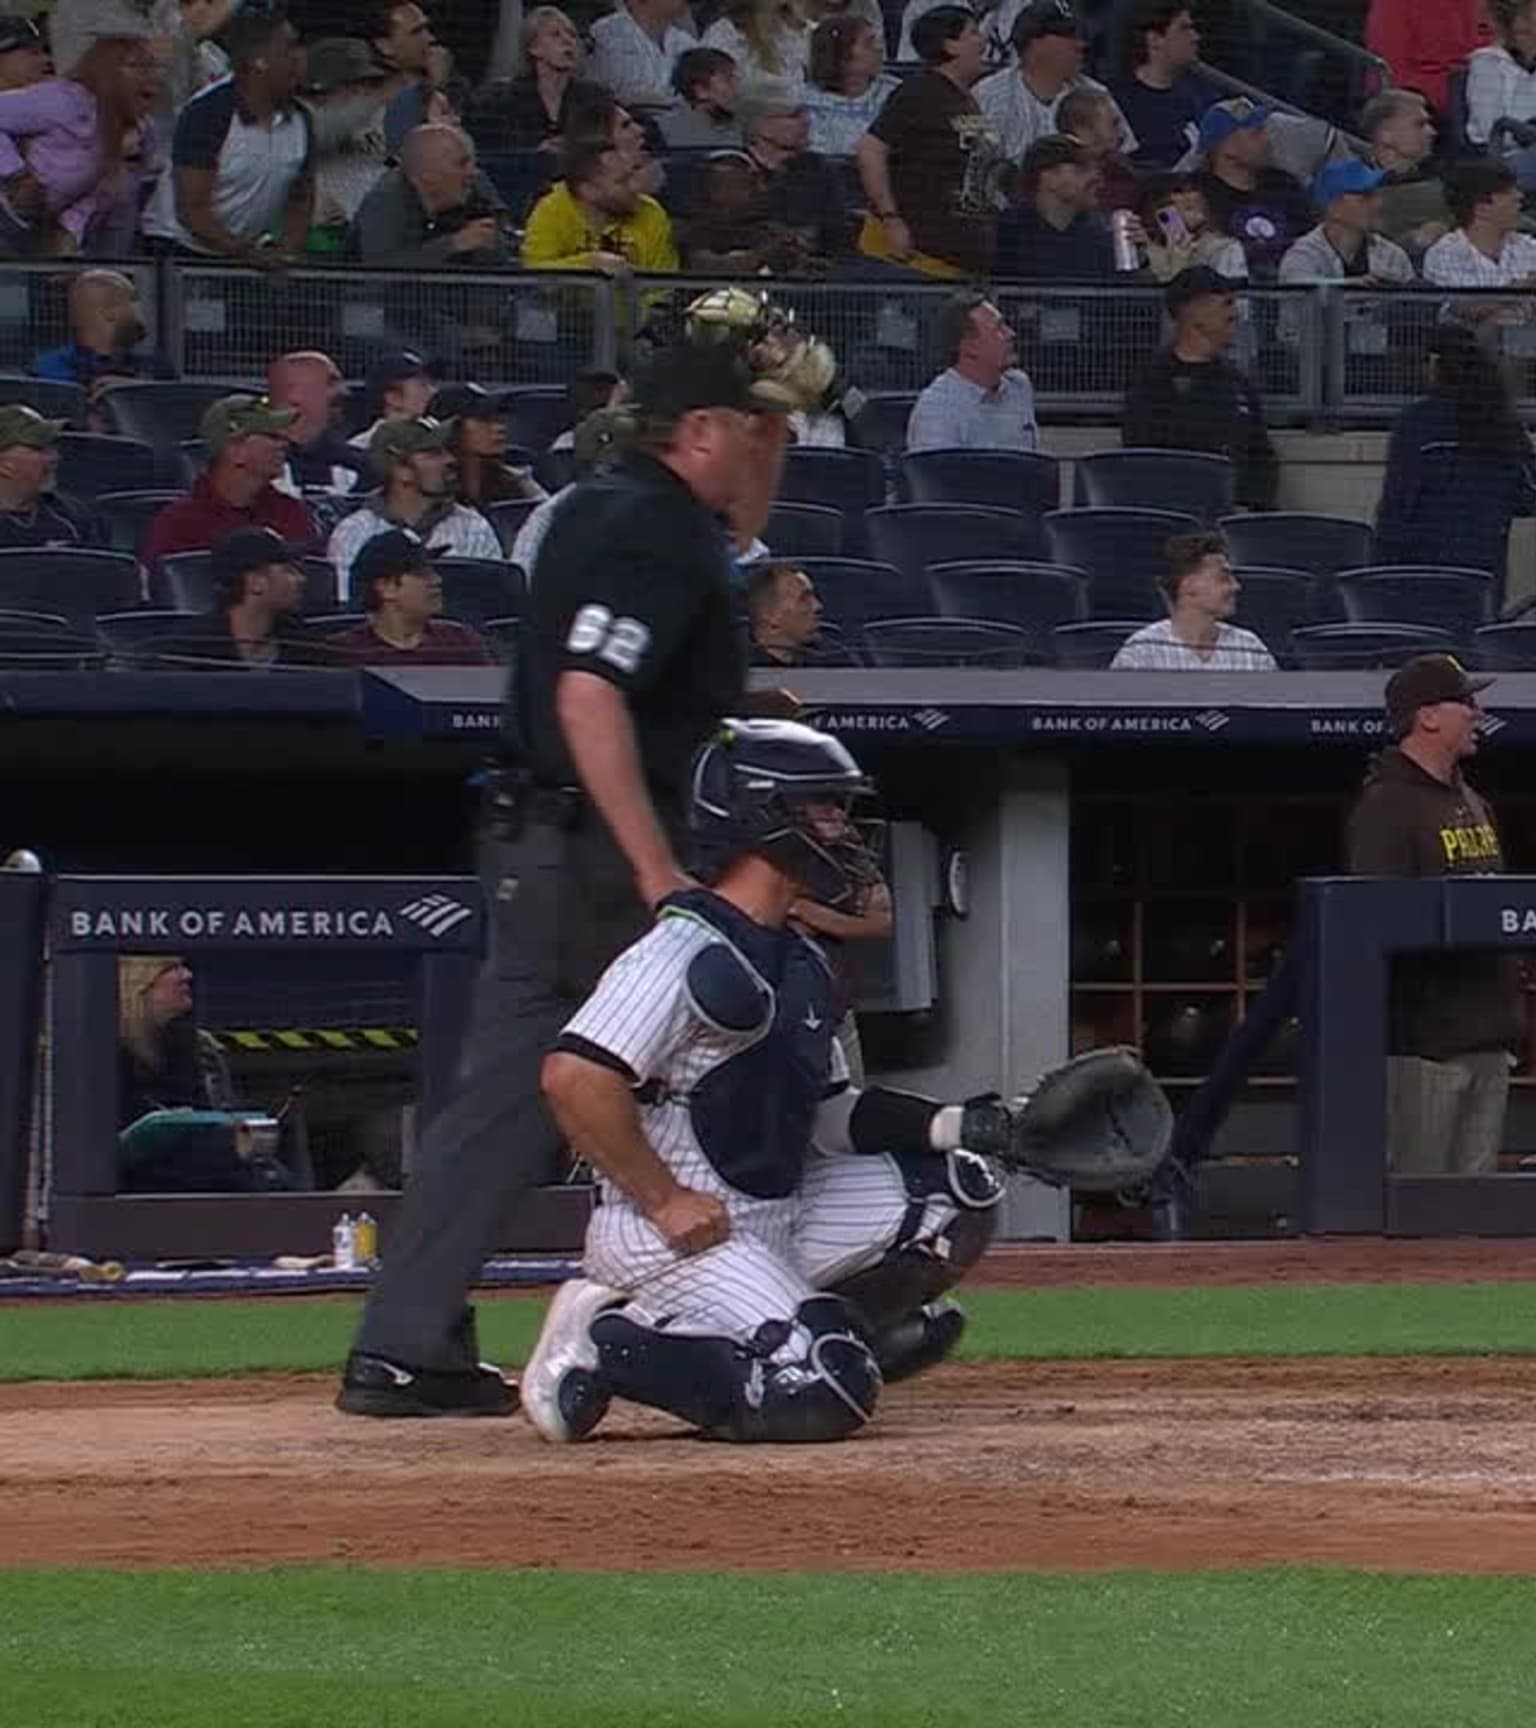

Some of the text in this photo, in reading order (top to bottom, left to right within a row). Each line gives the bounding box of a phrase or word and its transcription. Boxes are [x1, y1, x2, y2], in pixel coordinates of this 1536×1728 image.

[827, 716, 909, 729] AMERICA
[1031, 717, 1192, 731] BANK OF AMERICA
[1311, 719, 1360, 733] BANK
[1362, 719, 1385, 734] OF
[71, 911, 393, 936] BANK OF AMERICA
